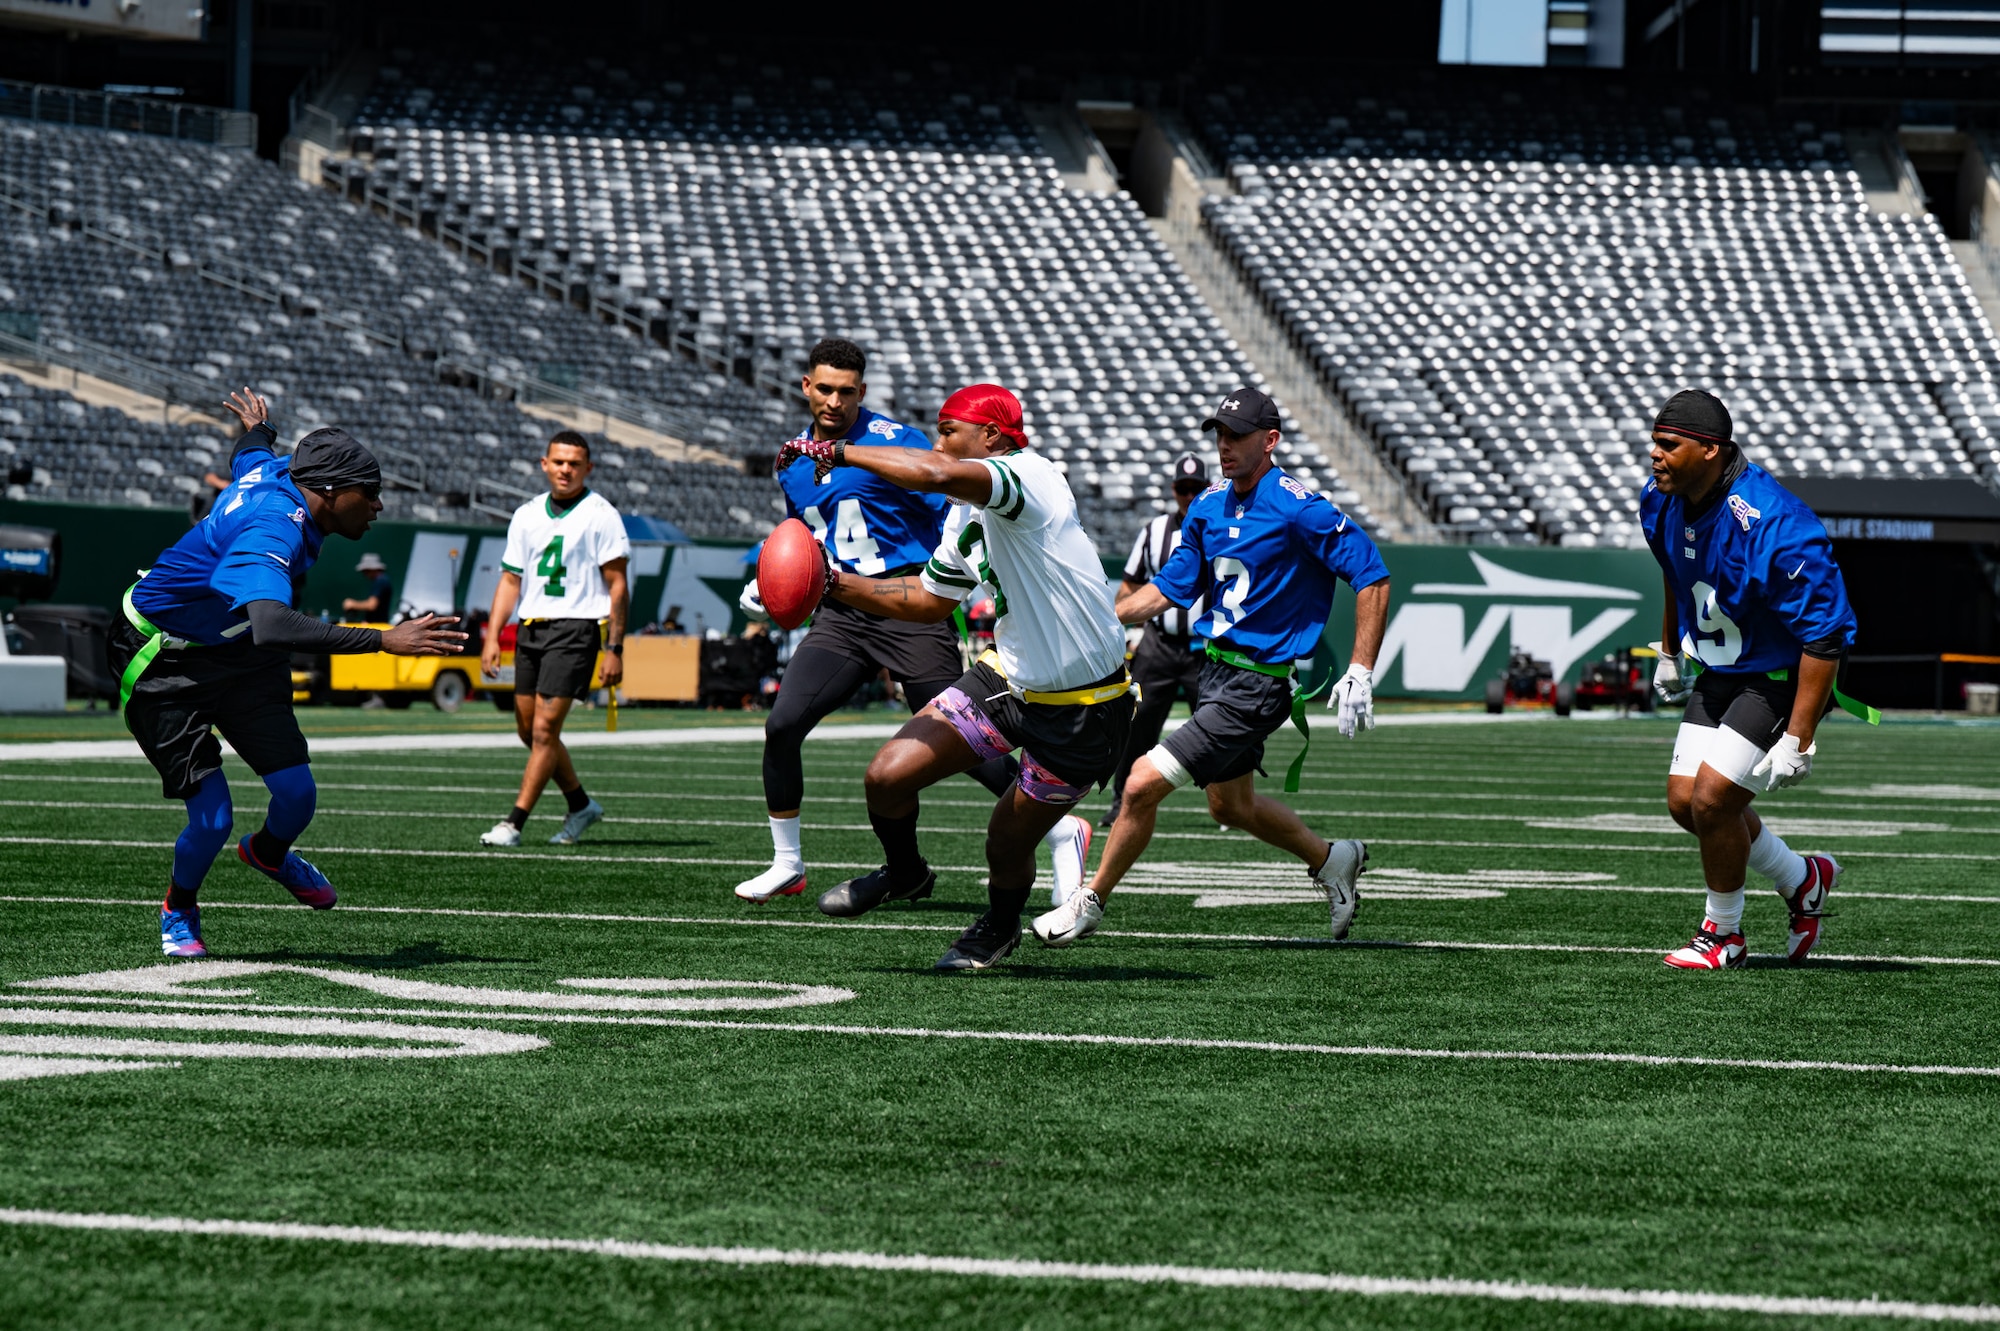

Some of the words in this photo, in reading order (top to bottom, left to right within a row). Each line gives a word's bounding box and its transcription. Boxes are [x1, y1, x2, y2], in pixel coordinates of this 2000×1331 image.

[1865, 519, 1934, 540] STADIUM
[537, 535, 567, 597] 4
[1213, 556, 1250, 637] 3
[1372, 603, 1638, 692] NY
